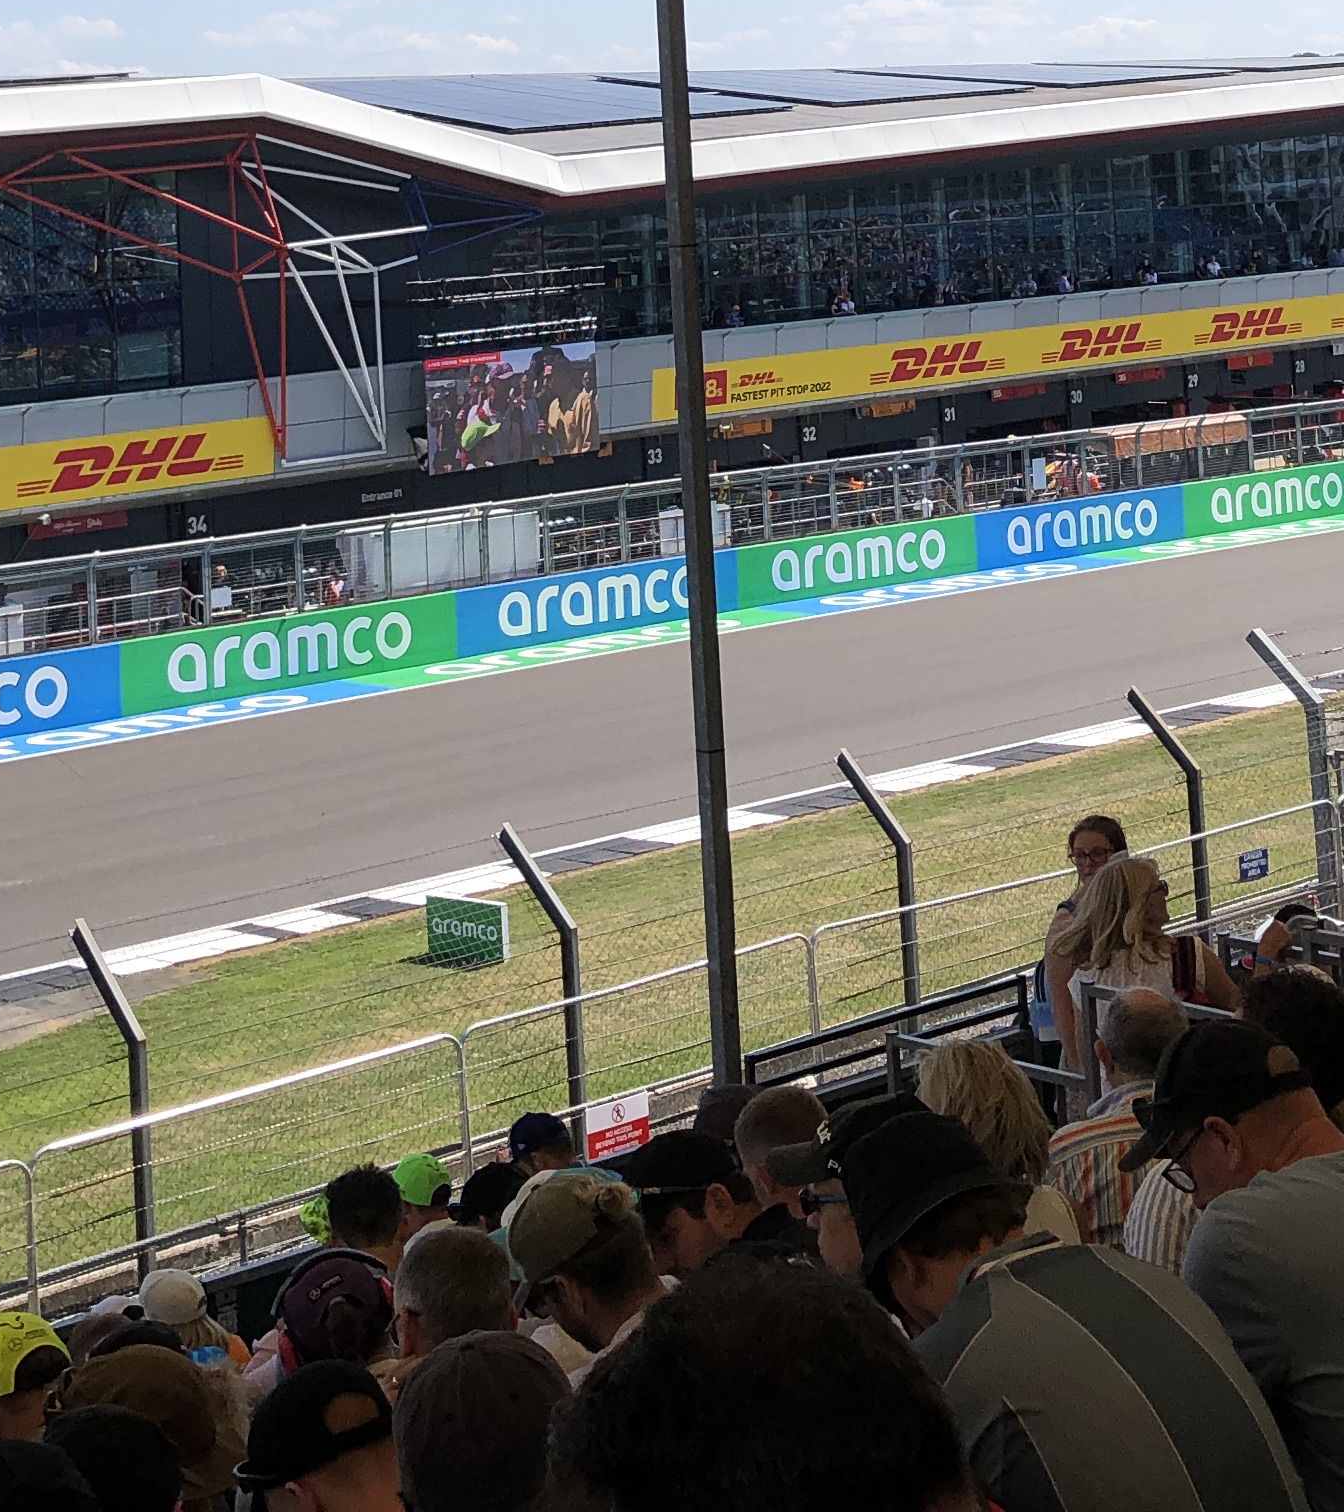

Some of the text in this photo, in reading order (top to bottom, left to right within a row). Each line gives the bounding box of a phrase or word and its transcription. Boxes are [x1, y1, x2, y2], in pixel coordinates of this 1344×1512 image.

[1210, 307, 1287, 343] DHL
[1059, 323, 1146, 363] DHL
[889, 341, 987, 383] DHL
[1295, 360, 1305, 373] 28
[705, 379, 723, 398] 8s
[739, 371, 775, 388] DHL
[731, 382, 831, 403] FASTEST PIT STOP 2022
[1071, 390, 1083, 404] 30
[944, 406, 956, 423] 31
[802, 426, 817, 442] 32
[50, 433, 215, 493] DHL
[647, 447, 663, 464] 33
[361, 488, 403, 503] Entrance 01
[1211, 471, 1343, 524] aramco
[187, 515, 207, 535] 34
[1008, 498, 1158, 556] aramco
[772, 528, 946, 592] aramco
[820, 563, 1078, 606] aramco
[168, 611, 412, 694] aramco
[431, 916, 498, 943] aramco
